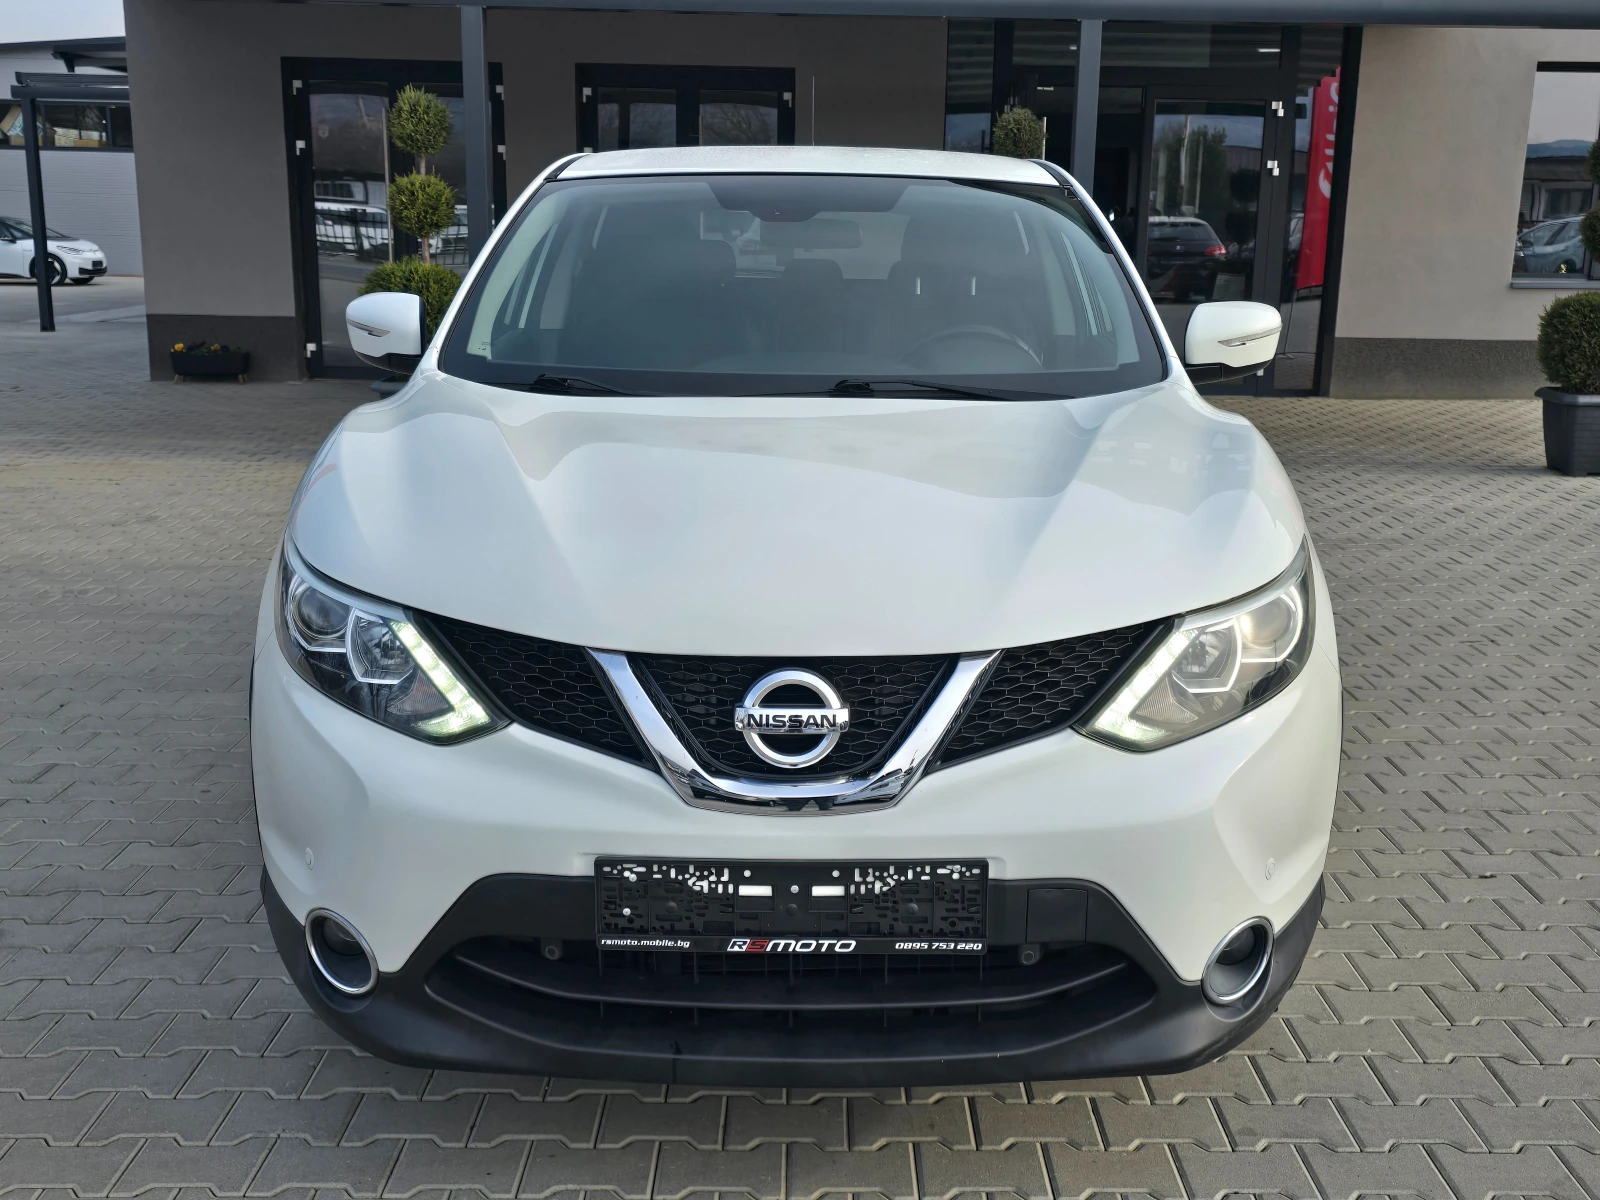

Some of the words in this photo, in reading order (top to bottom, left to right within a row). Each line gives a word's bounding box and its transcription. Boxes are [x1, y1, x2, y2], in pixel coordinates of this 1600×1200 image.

[747, 713, 837, 728] NISSAN
[601, 939, 691, 949] rsmoto.mobile.bg
[895, 942, 929, 950] 0895
[931, 942, 955, 950] 753
[956, 942, 983, 951] 220
